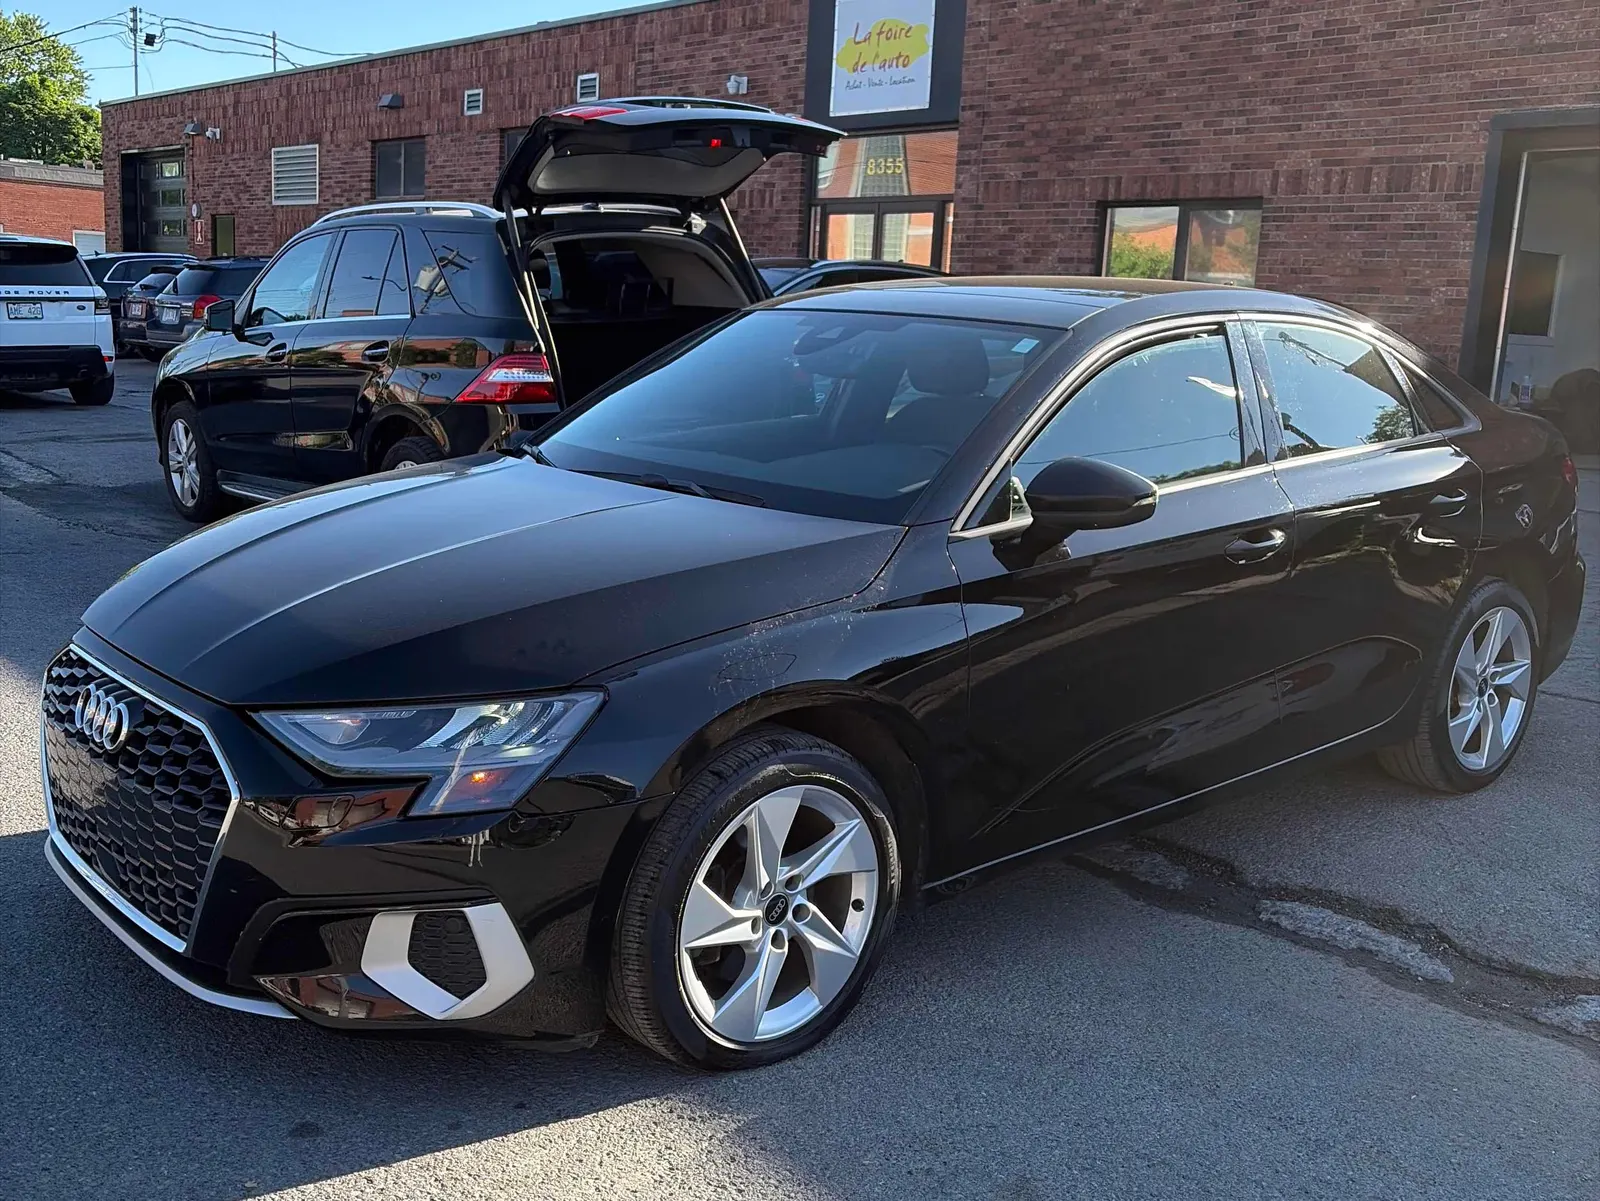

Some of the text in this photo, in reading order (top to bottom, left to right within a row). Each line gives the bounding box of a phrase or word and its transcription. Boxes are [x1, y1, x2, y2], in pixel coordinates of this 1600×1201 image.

[853, 22, 913, 48] La foire
[852, 52, 867, 74] de
[867, 157, 904, 175] 8355
